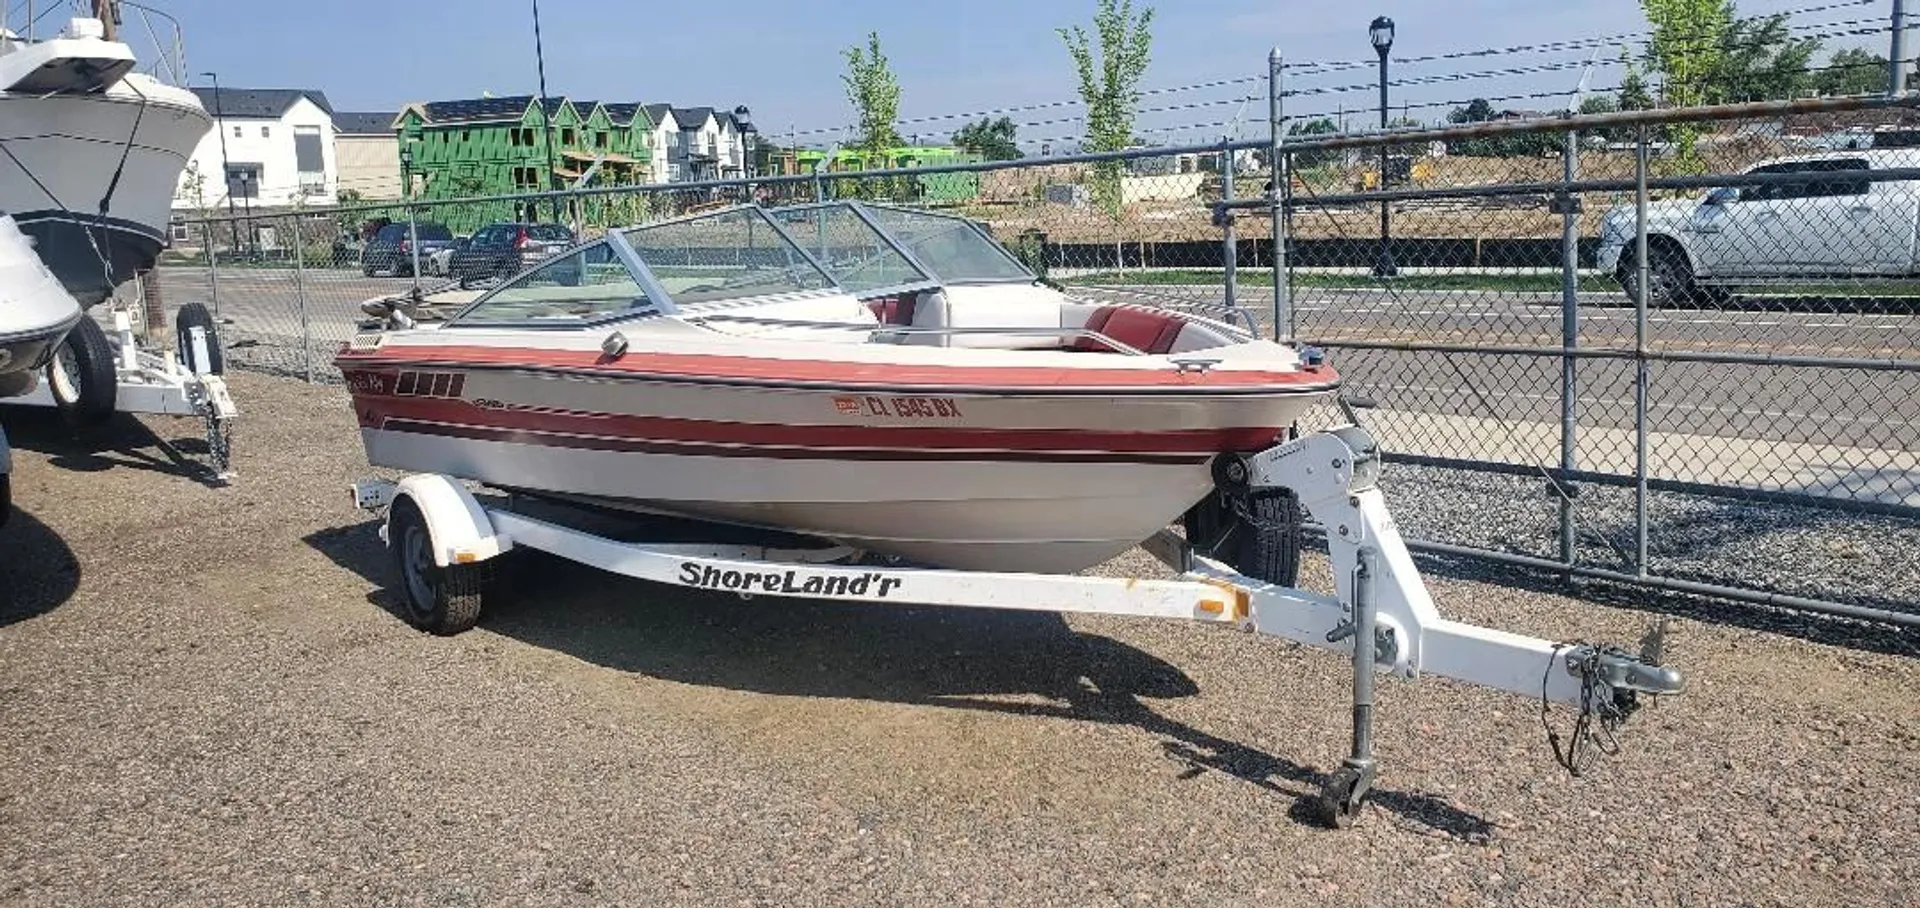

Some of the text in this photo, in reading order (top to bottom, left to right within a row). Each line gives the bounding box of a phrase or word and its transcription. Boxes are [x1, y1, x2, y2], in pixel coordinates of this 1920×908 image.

[865, 396, 892, 416] CL
[930, 398, 963, 417] BX
[679, 562, 902, 597] ShoreLand'r
